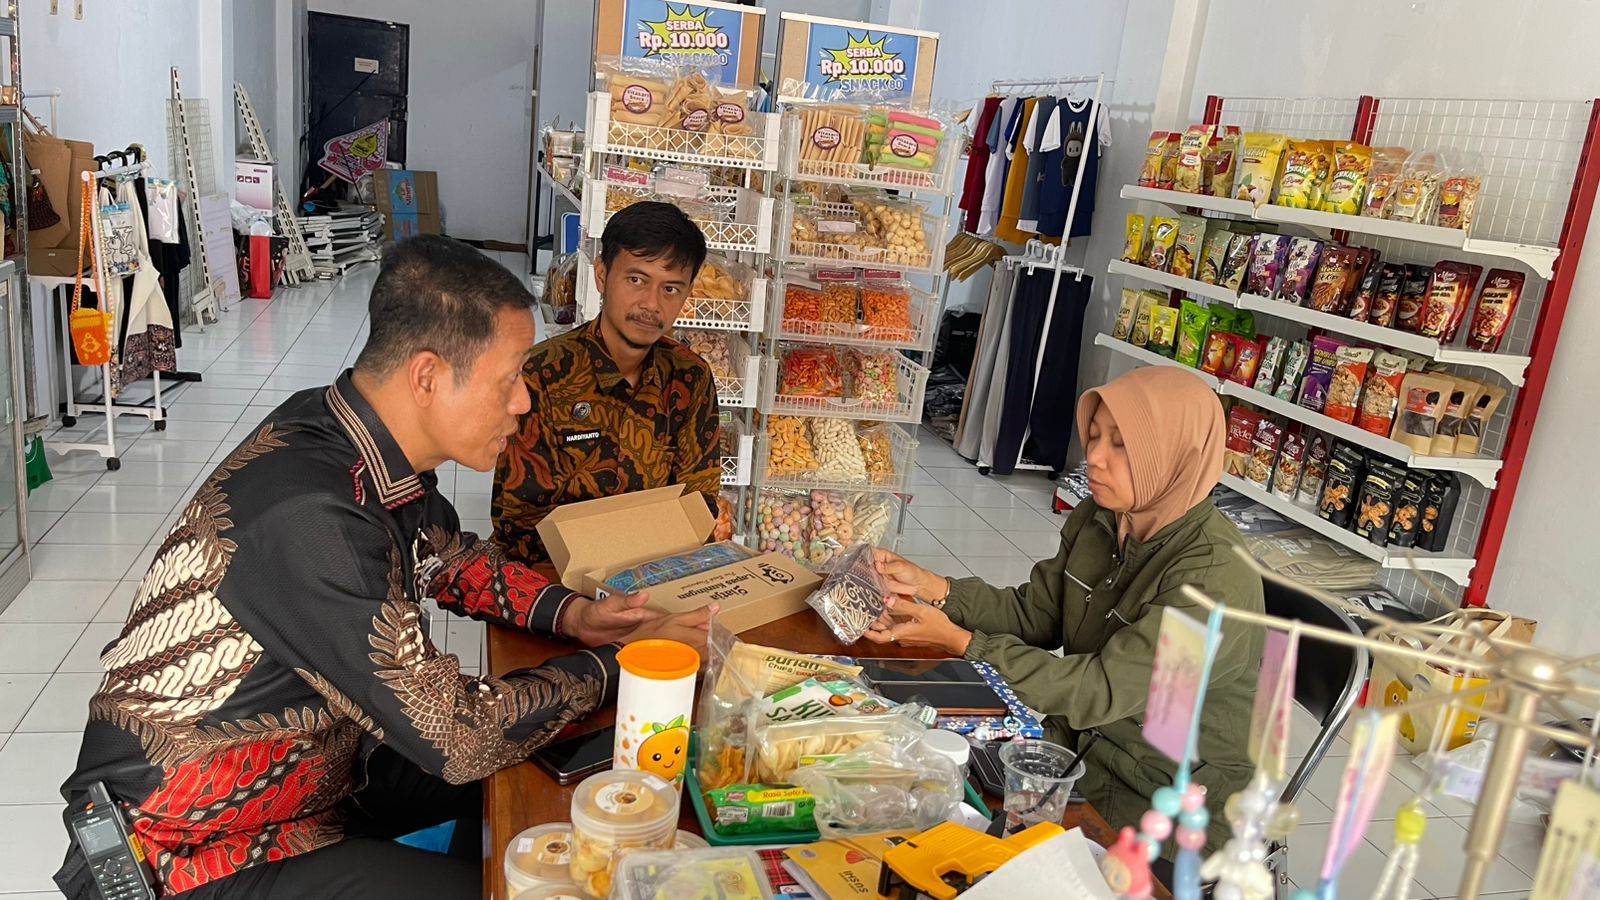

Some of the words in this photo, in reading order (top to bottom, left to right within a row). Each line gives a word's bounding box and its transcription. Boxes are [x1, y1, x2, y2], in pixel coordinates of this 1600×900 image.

[666, 20, 704, 31] SERBA
[638, 31, 668, 51] Rp.
[670, 32, 728, 48] 10.000
[846, 47, 882, 58] SERBA
[661, 53, 713, 66] SNACK
[821, 59, 848, 78] Rp.
[849, 59, 904, 75] 10.000
[841, 78, 888, 91] SNACK
[889, 79, 903, 90] 80
[566, 432, 600, 442] HARDIYANTO
[677, 582, 727, 600] Kuningan
[843, 870, 868, 893] SUSHI
